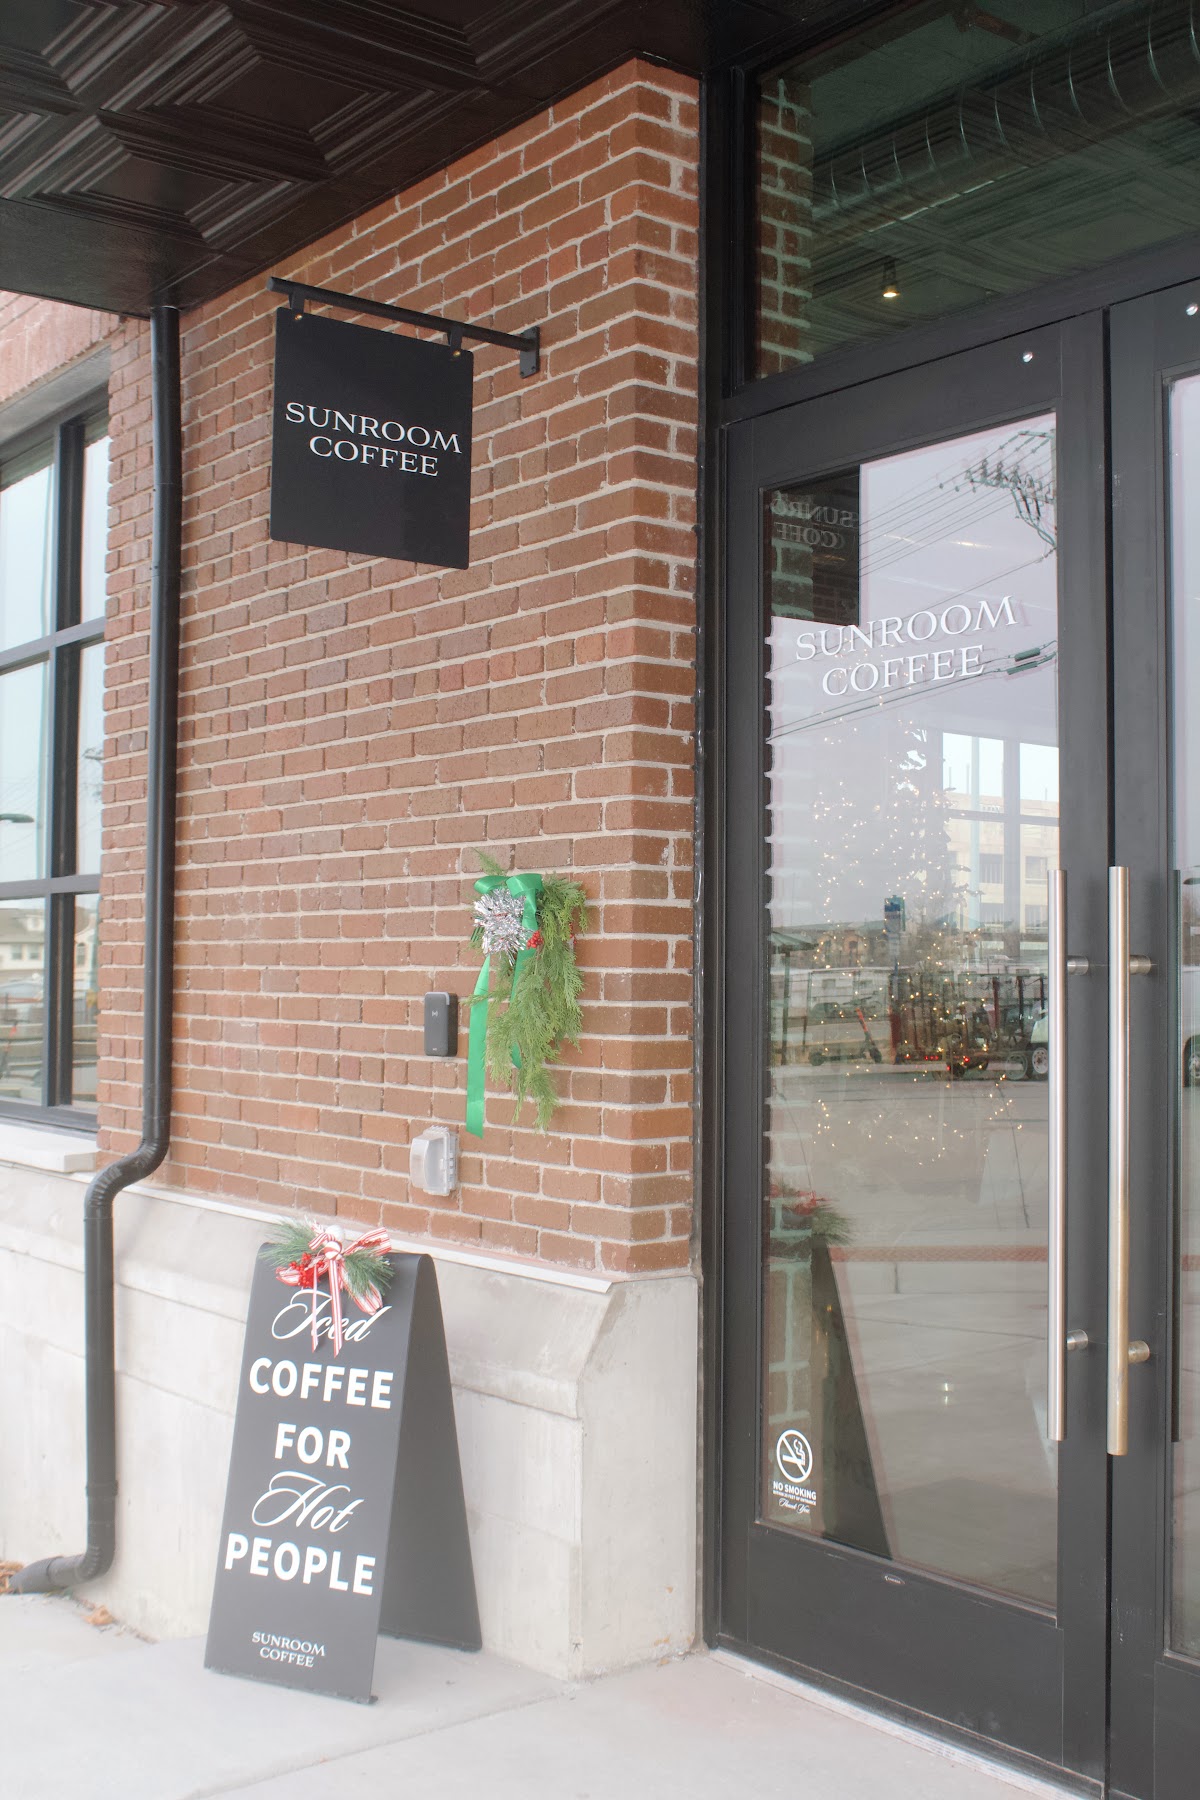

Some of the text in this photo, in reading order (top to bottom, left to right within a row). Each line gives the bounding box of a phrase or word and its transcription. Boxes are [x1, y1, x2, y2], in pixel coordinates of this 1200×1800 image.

[285, 402, 462, 454] SUNROOM
[309, 436, 439, 477] COFFEE
[796, 595, 1018, 660] SUNROOM
[822, 644, 986, 696] COFFEE
[249, 1357, 394, 1410] COFFEE
[274, 1422, 352, 1469] FOR
[251, 1470, 365, 1533] Hot
[773, 1480, 784, 1491] NO
[784, 1483, 817, 1501] SMOKING
[224, 1532, 376, 1596] PEOPLE
[251, 1631, 326, 1657] SUNROOM
[259, 1646, 315, 1668] COFFEE
